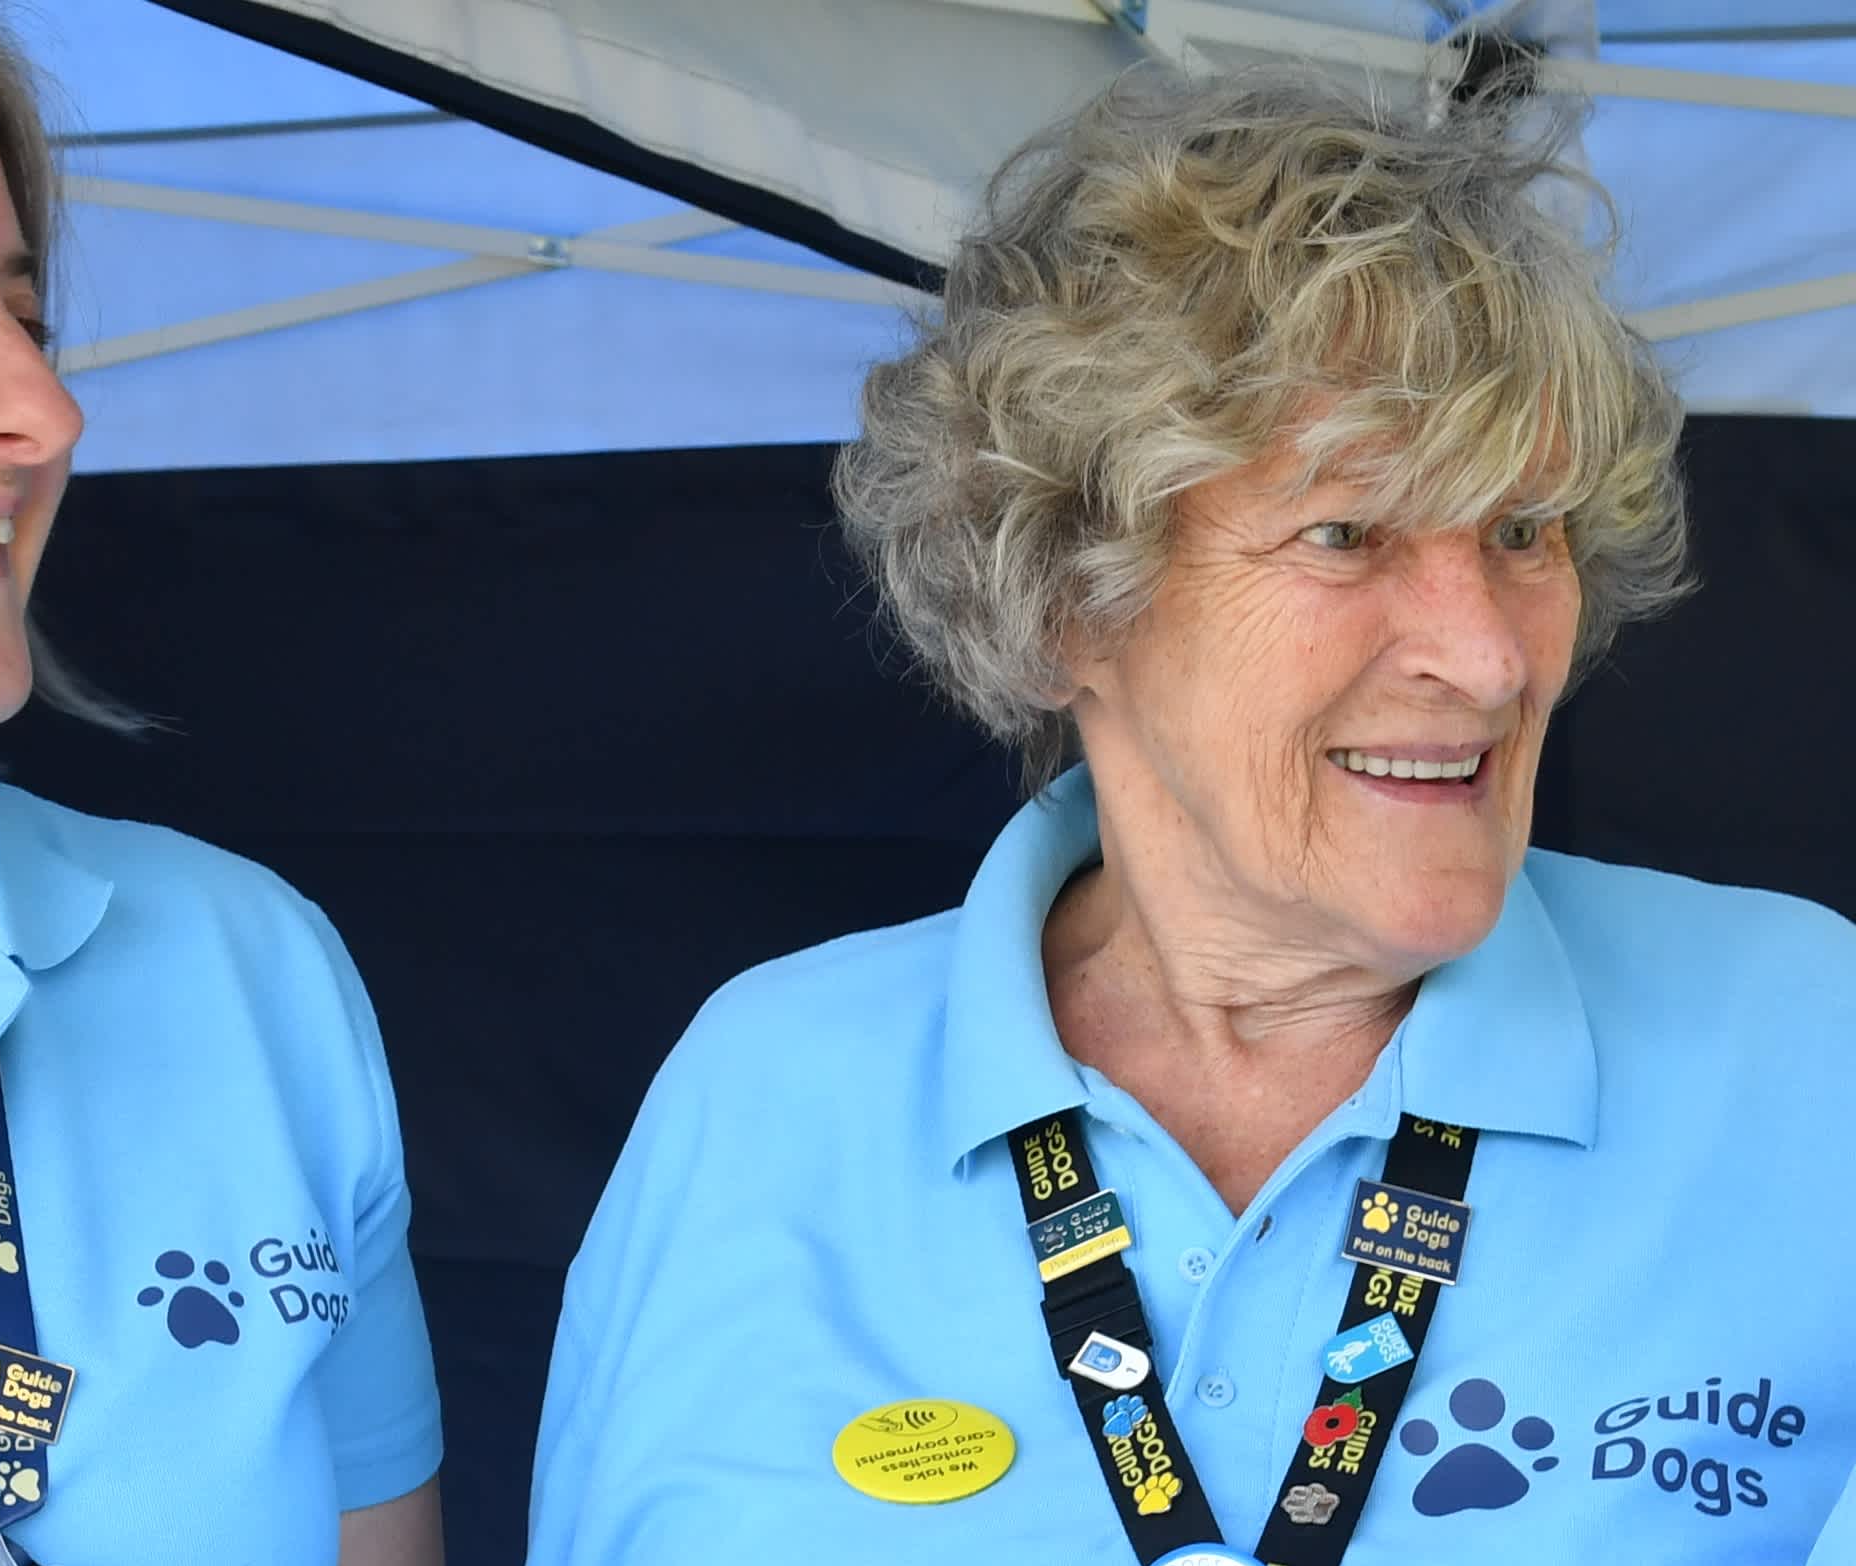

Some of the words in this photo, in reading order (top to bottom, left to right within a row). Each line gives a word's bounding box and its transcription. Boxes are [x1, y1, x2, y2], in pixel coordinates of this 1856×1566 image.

[1024, 1134, 1053, 1200] GUIDE
[1046, 1121, 1079, 1191] DOGS
[1074, 1217, 1110, 1240] Dogs
[1406, 1204, 1460, 1233] Guide
[1403, 1222, 1450, 1250] Dogs
[249, 1227, 339, 1279] Guid
[1353, 1237, 1374, 1253] Pat
[1375, 1243, 1393, 1258] on
[1394, 1248, 1415, 1264] the
[1417, 1252, 1451, 1273] back
[1368, 1324, 1394, 1364] DOGS
[1382, 1318, 1409, 1361] GUIDE
[7, 1363, 62, 1394] Guide
[3, 1379, 52, 1409] Dogs
[16, 1411, 52, 1433] back
[1593, 1377, 1807, 1447] Guide
[855, 1437, 949, 1467] payments!
[954, 1430, 996, 1445] card
[881, 1445, 984, 1473] contactless
[949, 1461, 979, 1472] We
[1108, 1435, 1143, 1487] GUID
[903, 1467, 945, 1482] take
[1592, 1436, 1769, 1517] Dogs
